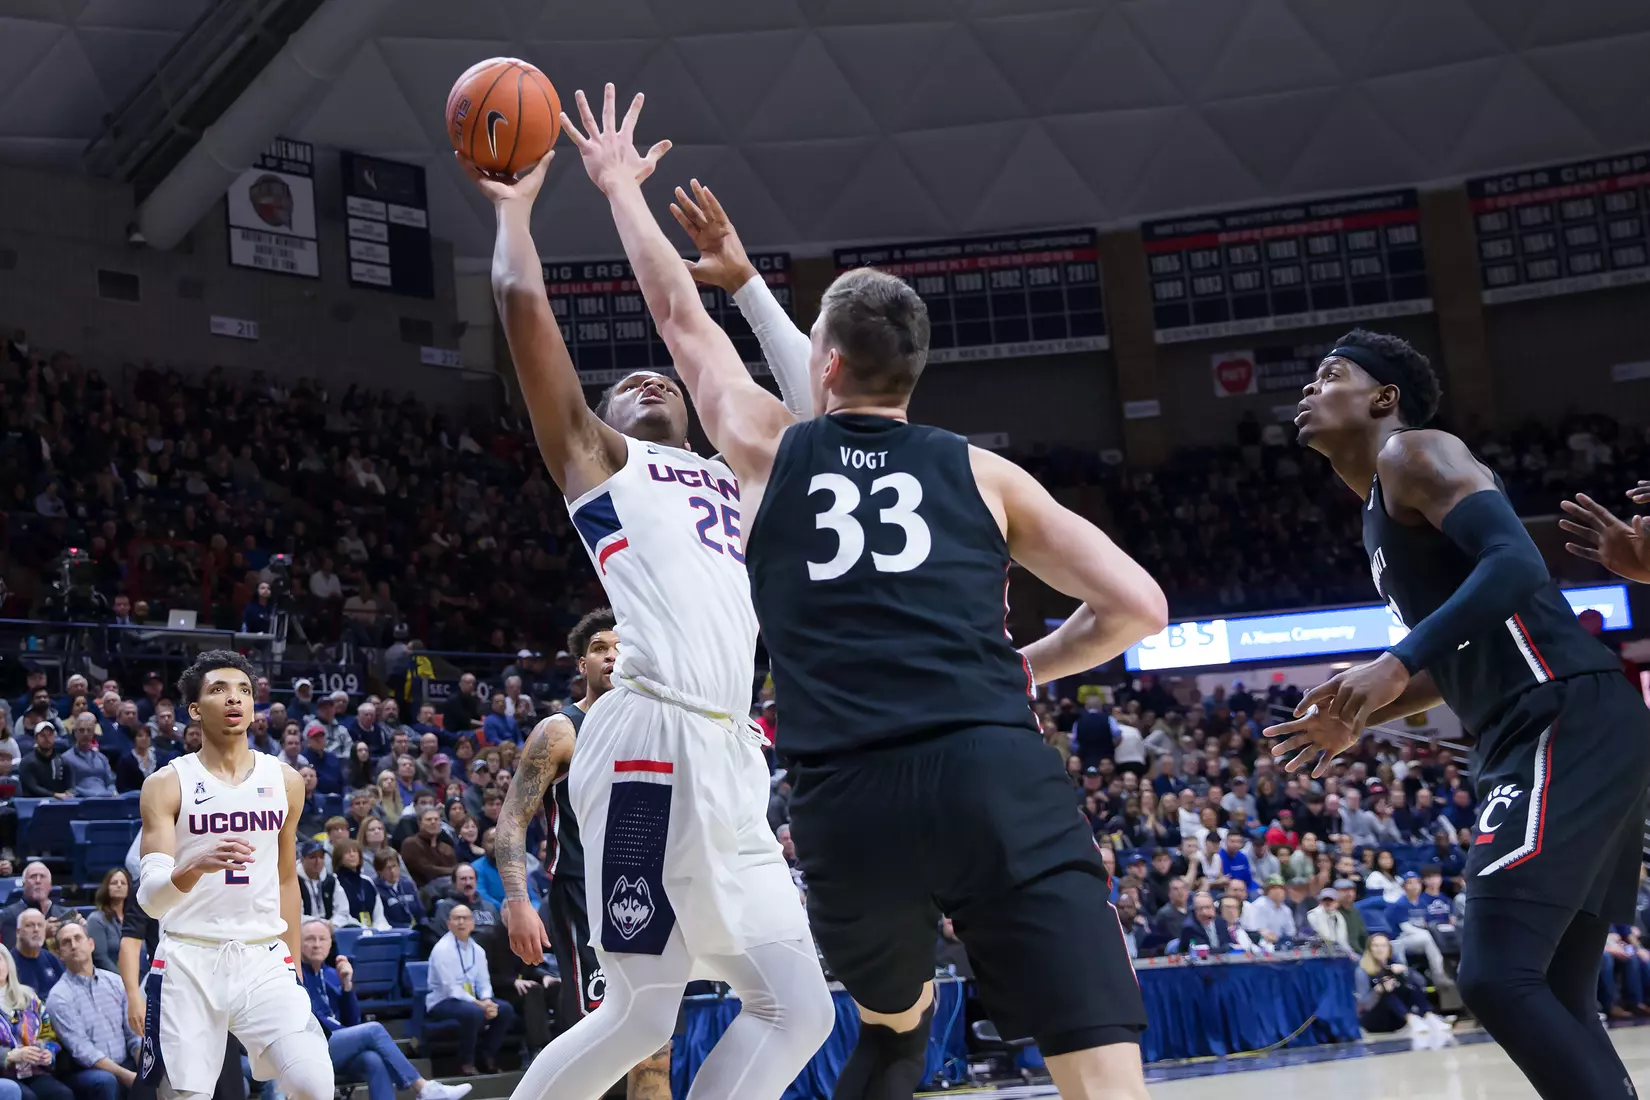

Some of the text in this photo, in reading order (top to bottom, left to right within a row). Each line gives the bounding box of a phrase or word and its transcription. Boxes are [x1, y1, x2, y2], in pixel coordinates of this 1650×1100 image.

[840, 445, 889, 470] VOGT
[688, 496, 746, 566] 25
[806, 472, 932, 581] 33
[319, 673, 359, 695] 109
[429, 683, 451, 696] SEC
[188, 809, 284, 836] UCONN
